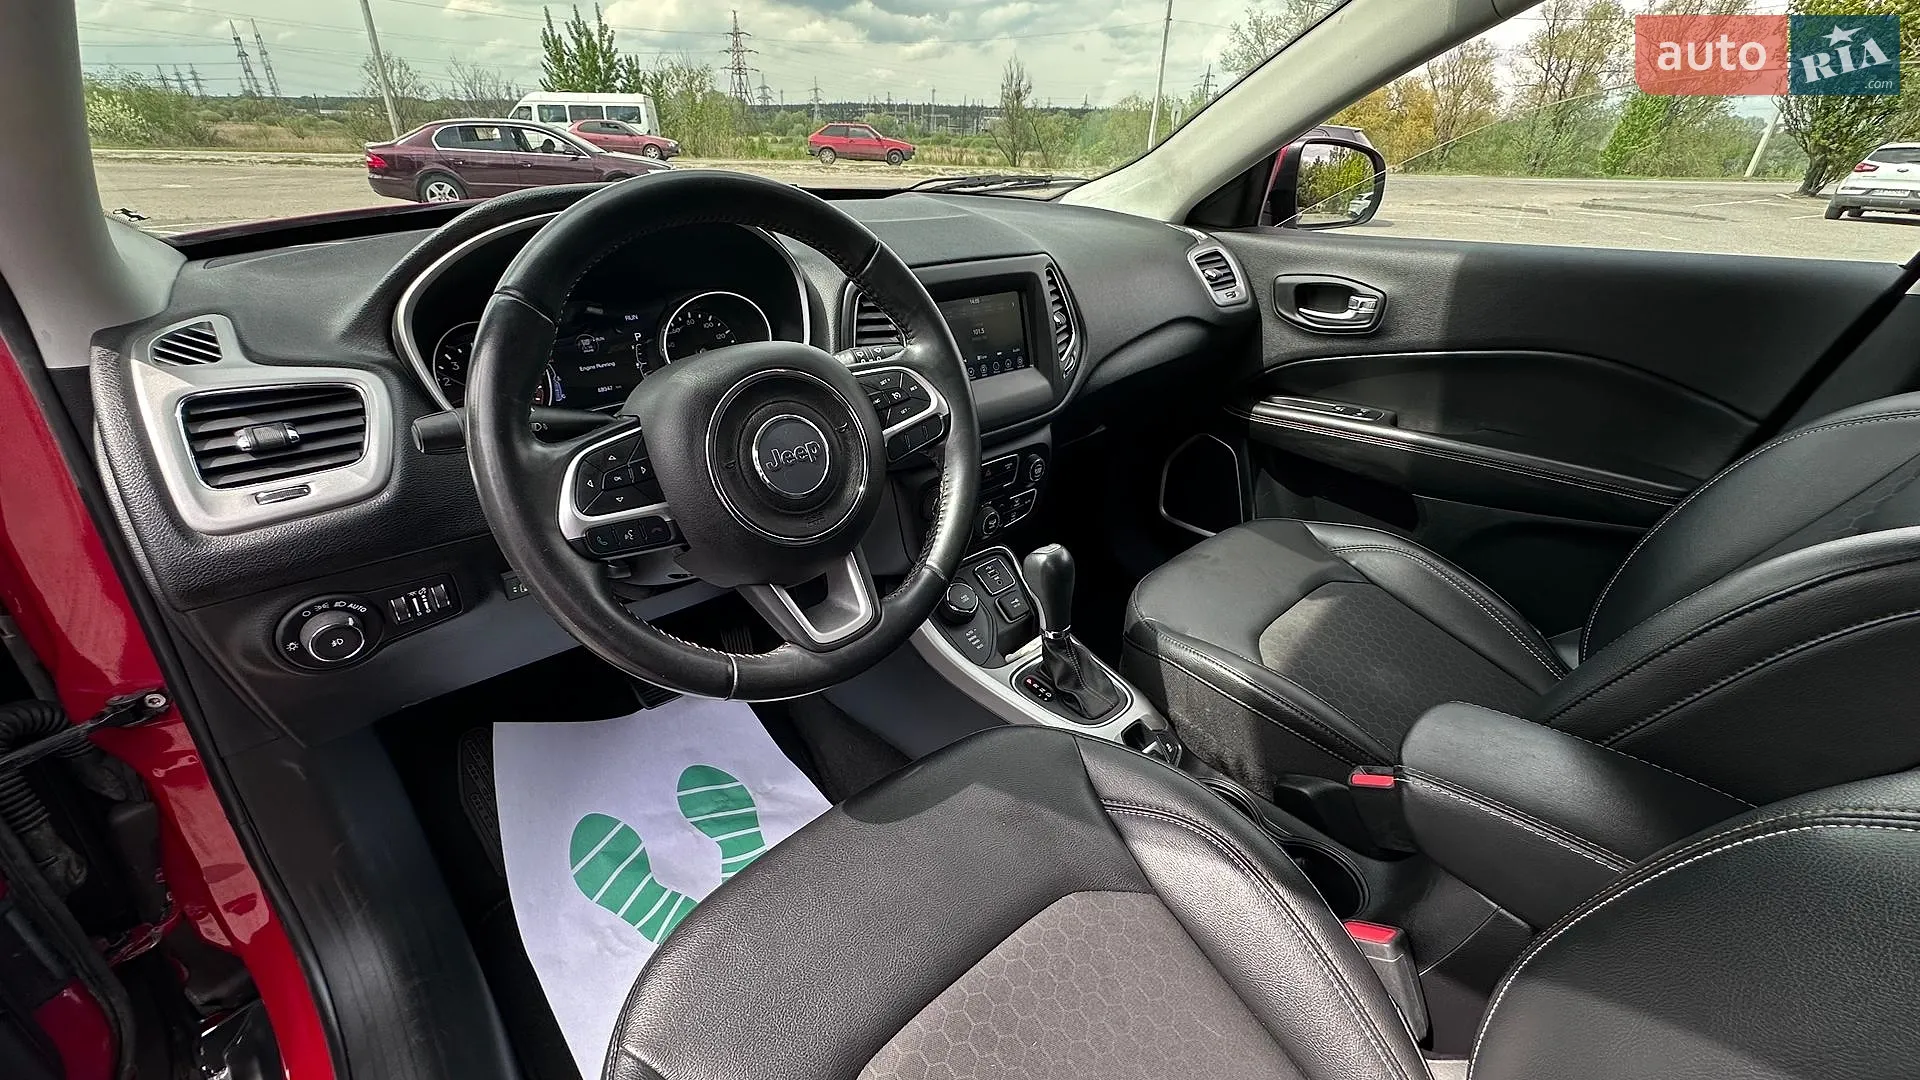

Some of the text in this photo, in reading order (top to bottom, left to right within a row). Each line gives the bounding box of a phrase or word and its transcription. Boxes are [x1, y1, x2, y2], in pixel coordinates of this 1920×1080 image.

[634, 332, 642, 341] P
[765, 441, 821, 470] Jeep
[347, 603, 367, 613] AUTO
